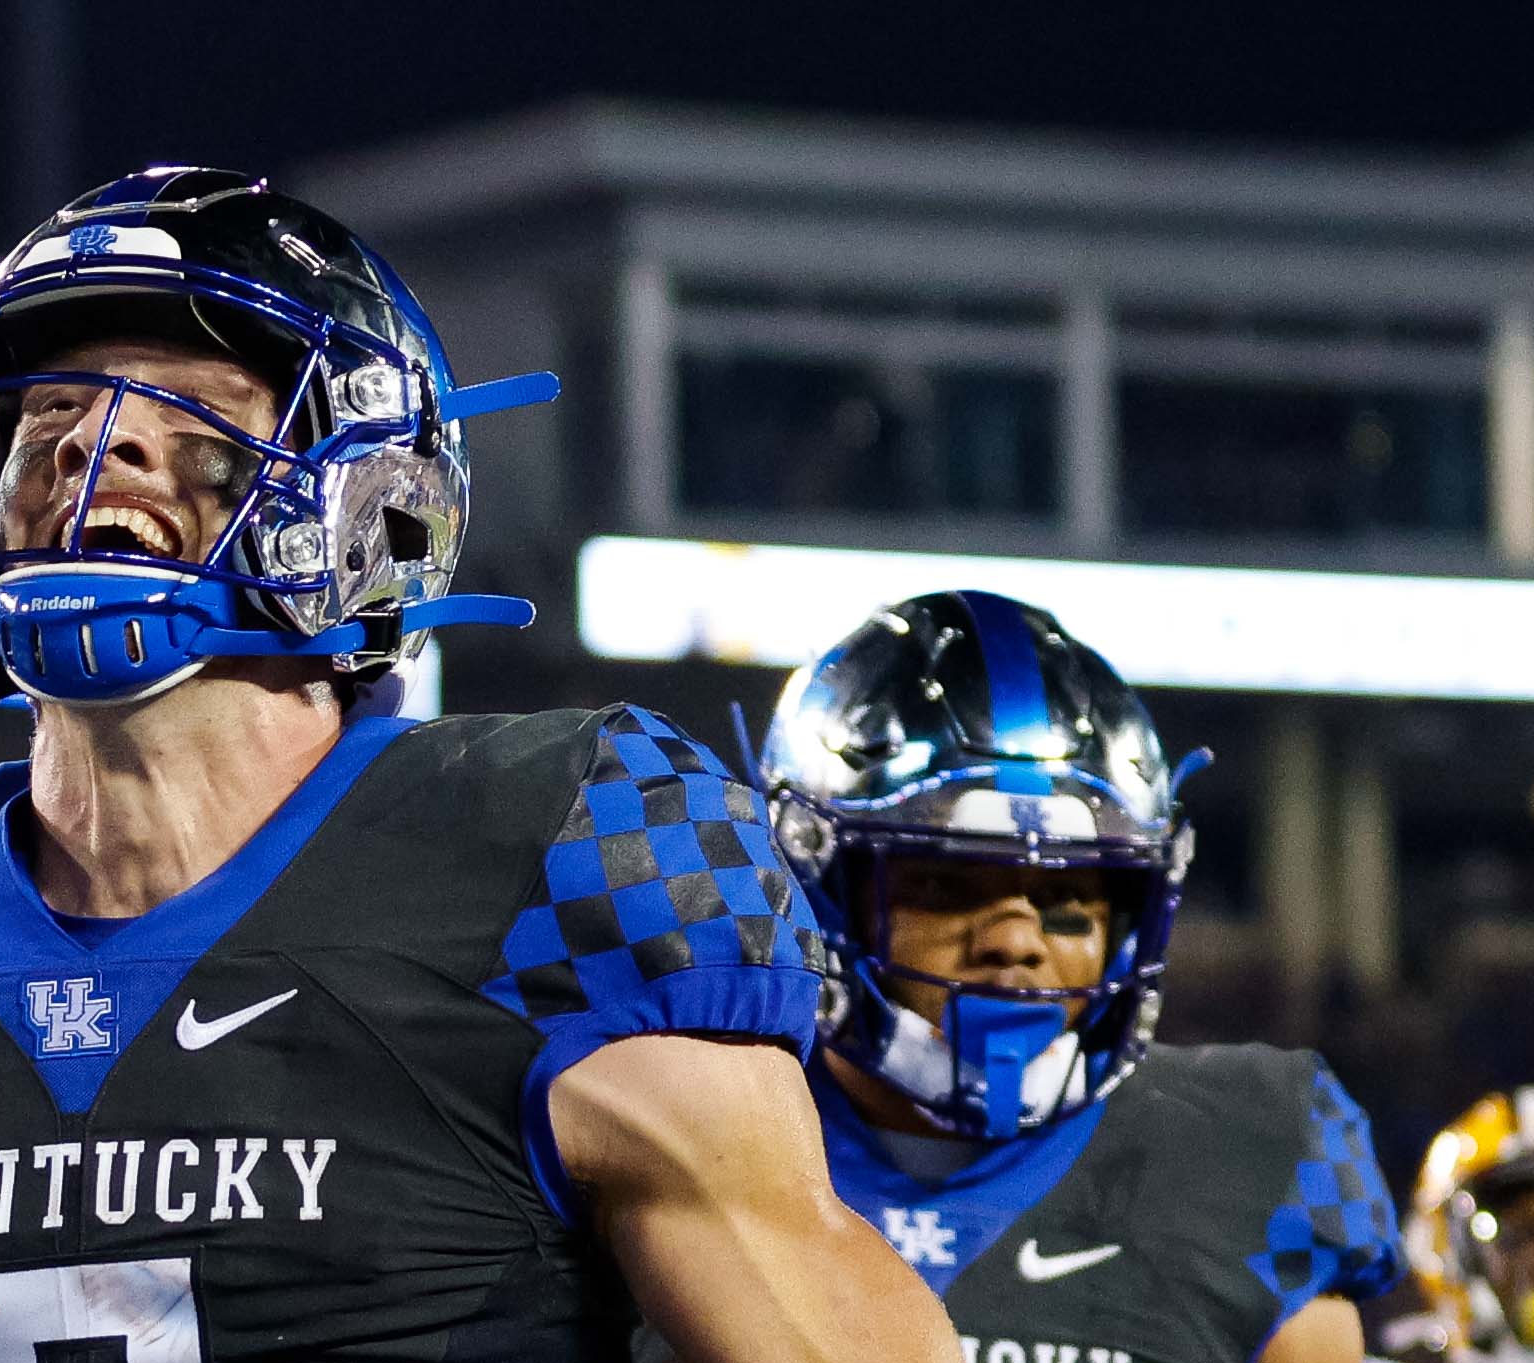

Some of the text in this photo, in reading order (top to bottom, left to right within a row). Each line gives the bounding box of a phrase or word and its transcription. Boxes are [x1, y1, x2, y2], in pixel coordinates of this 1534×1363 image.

[31, 596, 96, 611] Riddell
[27, 977, 112, 1053] UK
[883, 1208, 956, 1266] UK
